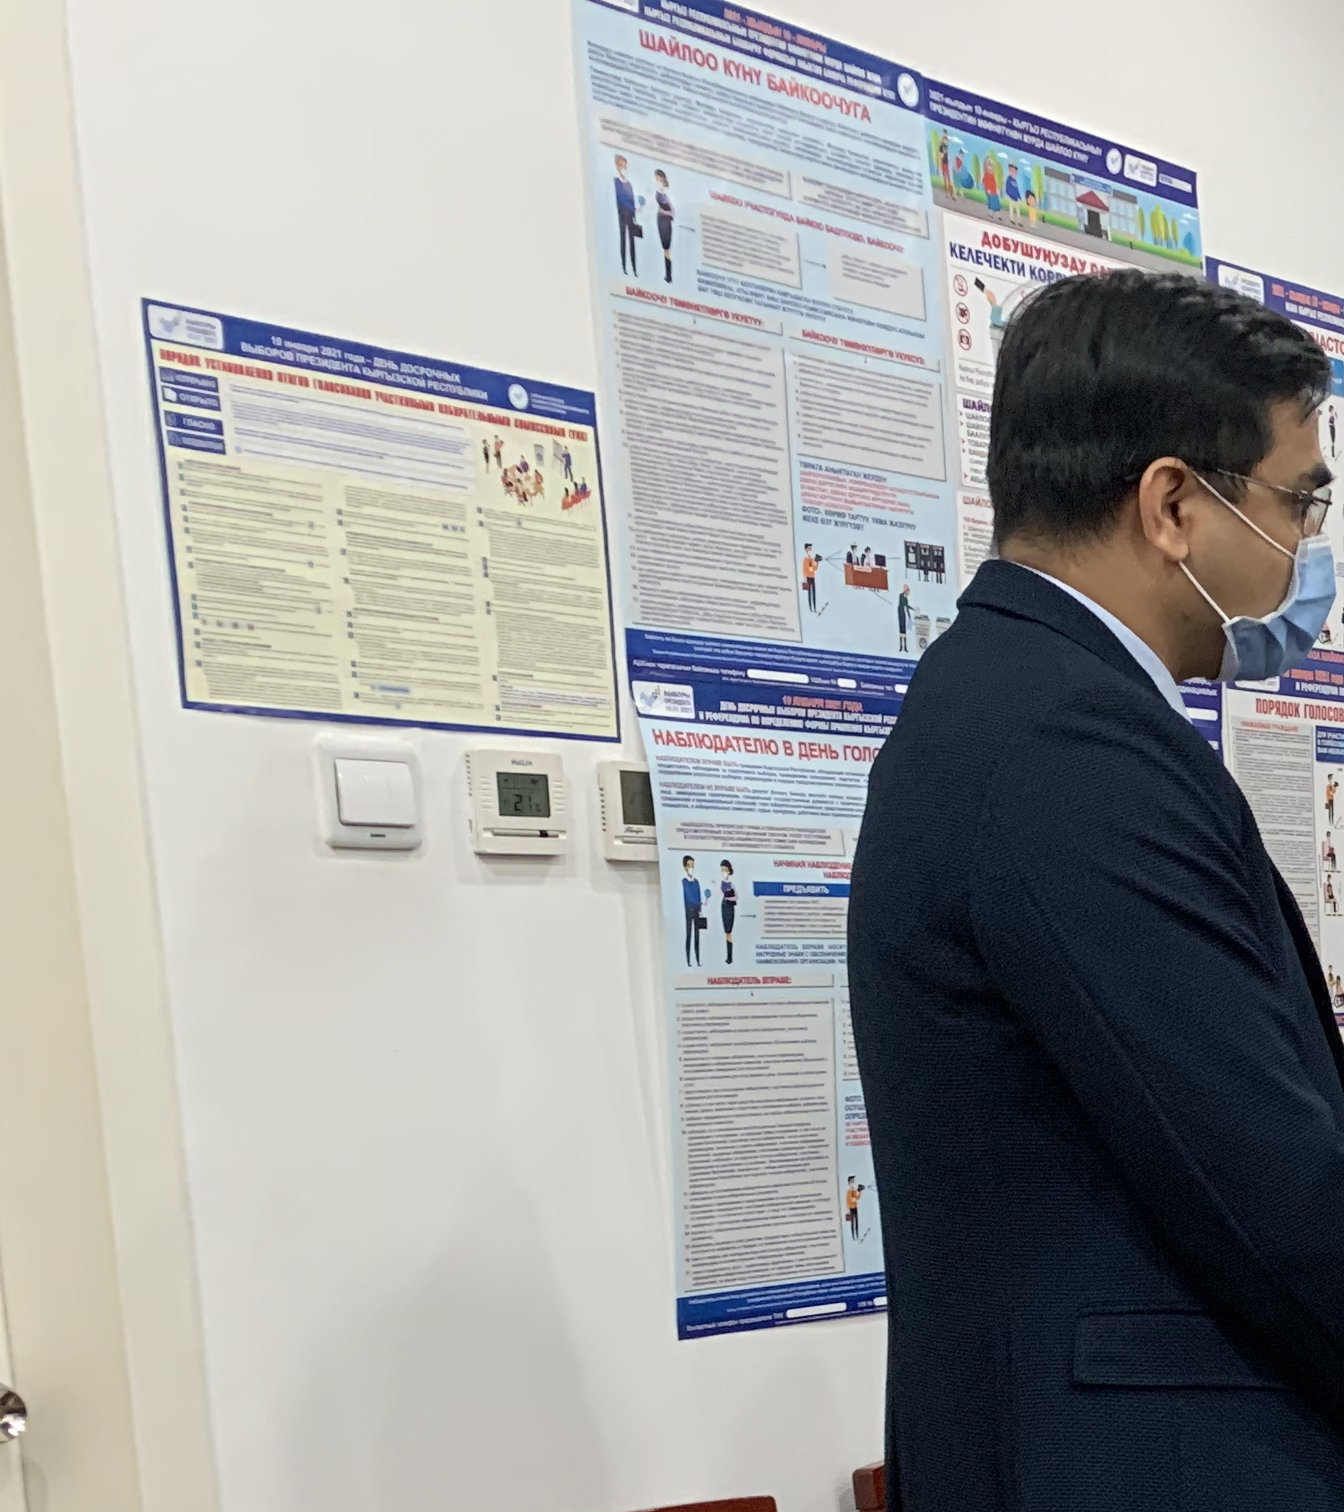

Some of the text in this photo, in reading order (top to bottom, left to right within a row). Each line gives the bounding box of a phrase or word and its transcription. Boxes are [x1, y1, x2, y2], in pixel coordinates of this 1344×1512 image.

[639, 28, 718, 72] ШАЙЛОО
[722, 56, 761, 86] КҮНҮ
[767, 72, 872, 124] БАЙКООЧУГА
[950, 241, 1026, 278] КЕЛЕЧЕКТИ
[981, 231, 1087, 274] ДОБУШУҢУЗДУ
[962, 398, 992, 413] ШАЙЛ
[1255, 698, 1300, 718] ПОРЯДОК
[651, 728, 779, 756] НАБЛЮДАТЕЛЮ
[783, 741, 794, 757] В
[798, 743, 839, 761] ДЕНЬ
